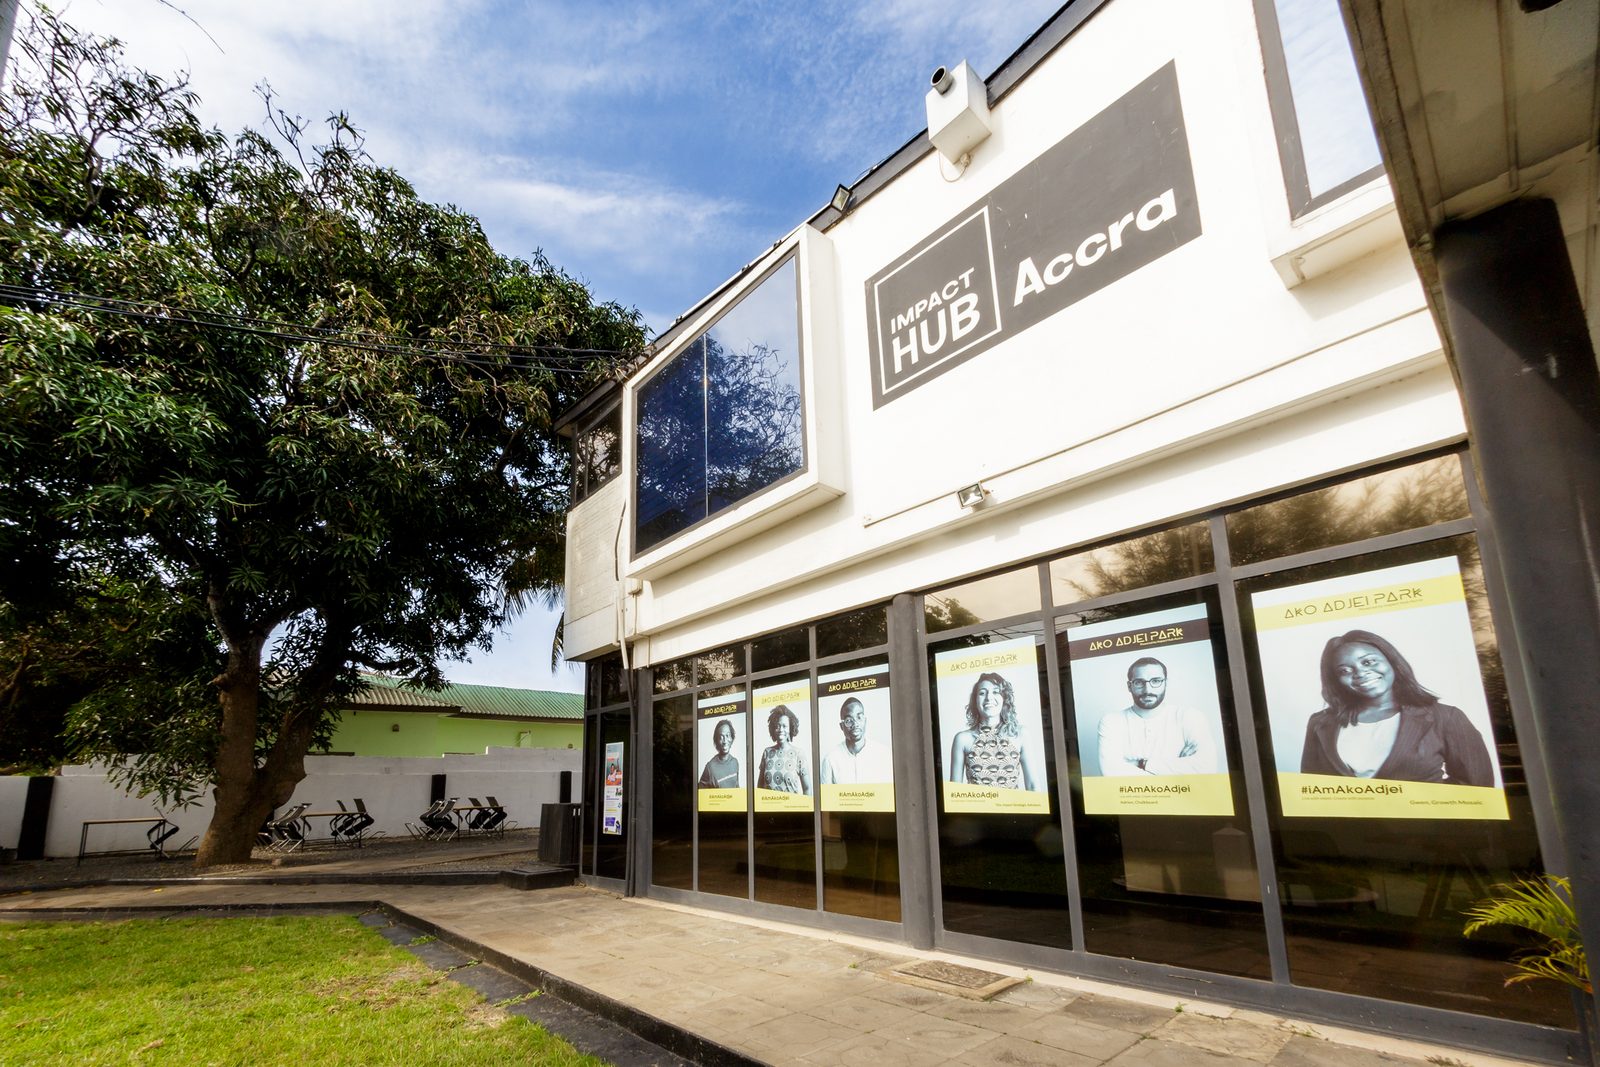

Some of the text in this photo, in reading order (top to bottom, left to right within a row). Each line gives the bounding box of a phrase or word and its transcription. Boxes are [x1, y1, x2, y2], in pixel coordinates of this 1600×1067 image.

[1013, 188, 1177, 307] Accra
[890, 267, 975, 335] IMPACT
[892, 293, 980, 374] HUB
[1284, 604, 1317, 619] AKO
[1323, 595, 1369, 612] ADJEI
[1374, 587, 1423, 603] PARK
[1089, 639, 1113, 651] AKO
[1116, 632, 1148, 647] ADJEI
[1150, 627, 1184, 640] PARK
[969, 657, 993, 668] ADJEI
[994, 653, 1018, 664] PARK
[1119, 784, 1191, 794] #iAmAkoAdjei
[1301, 785, 1403, 796] #iAmAkoAdjei
